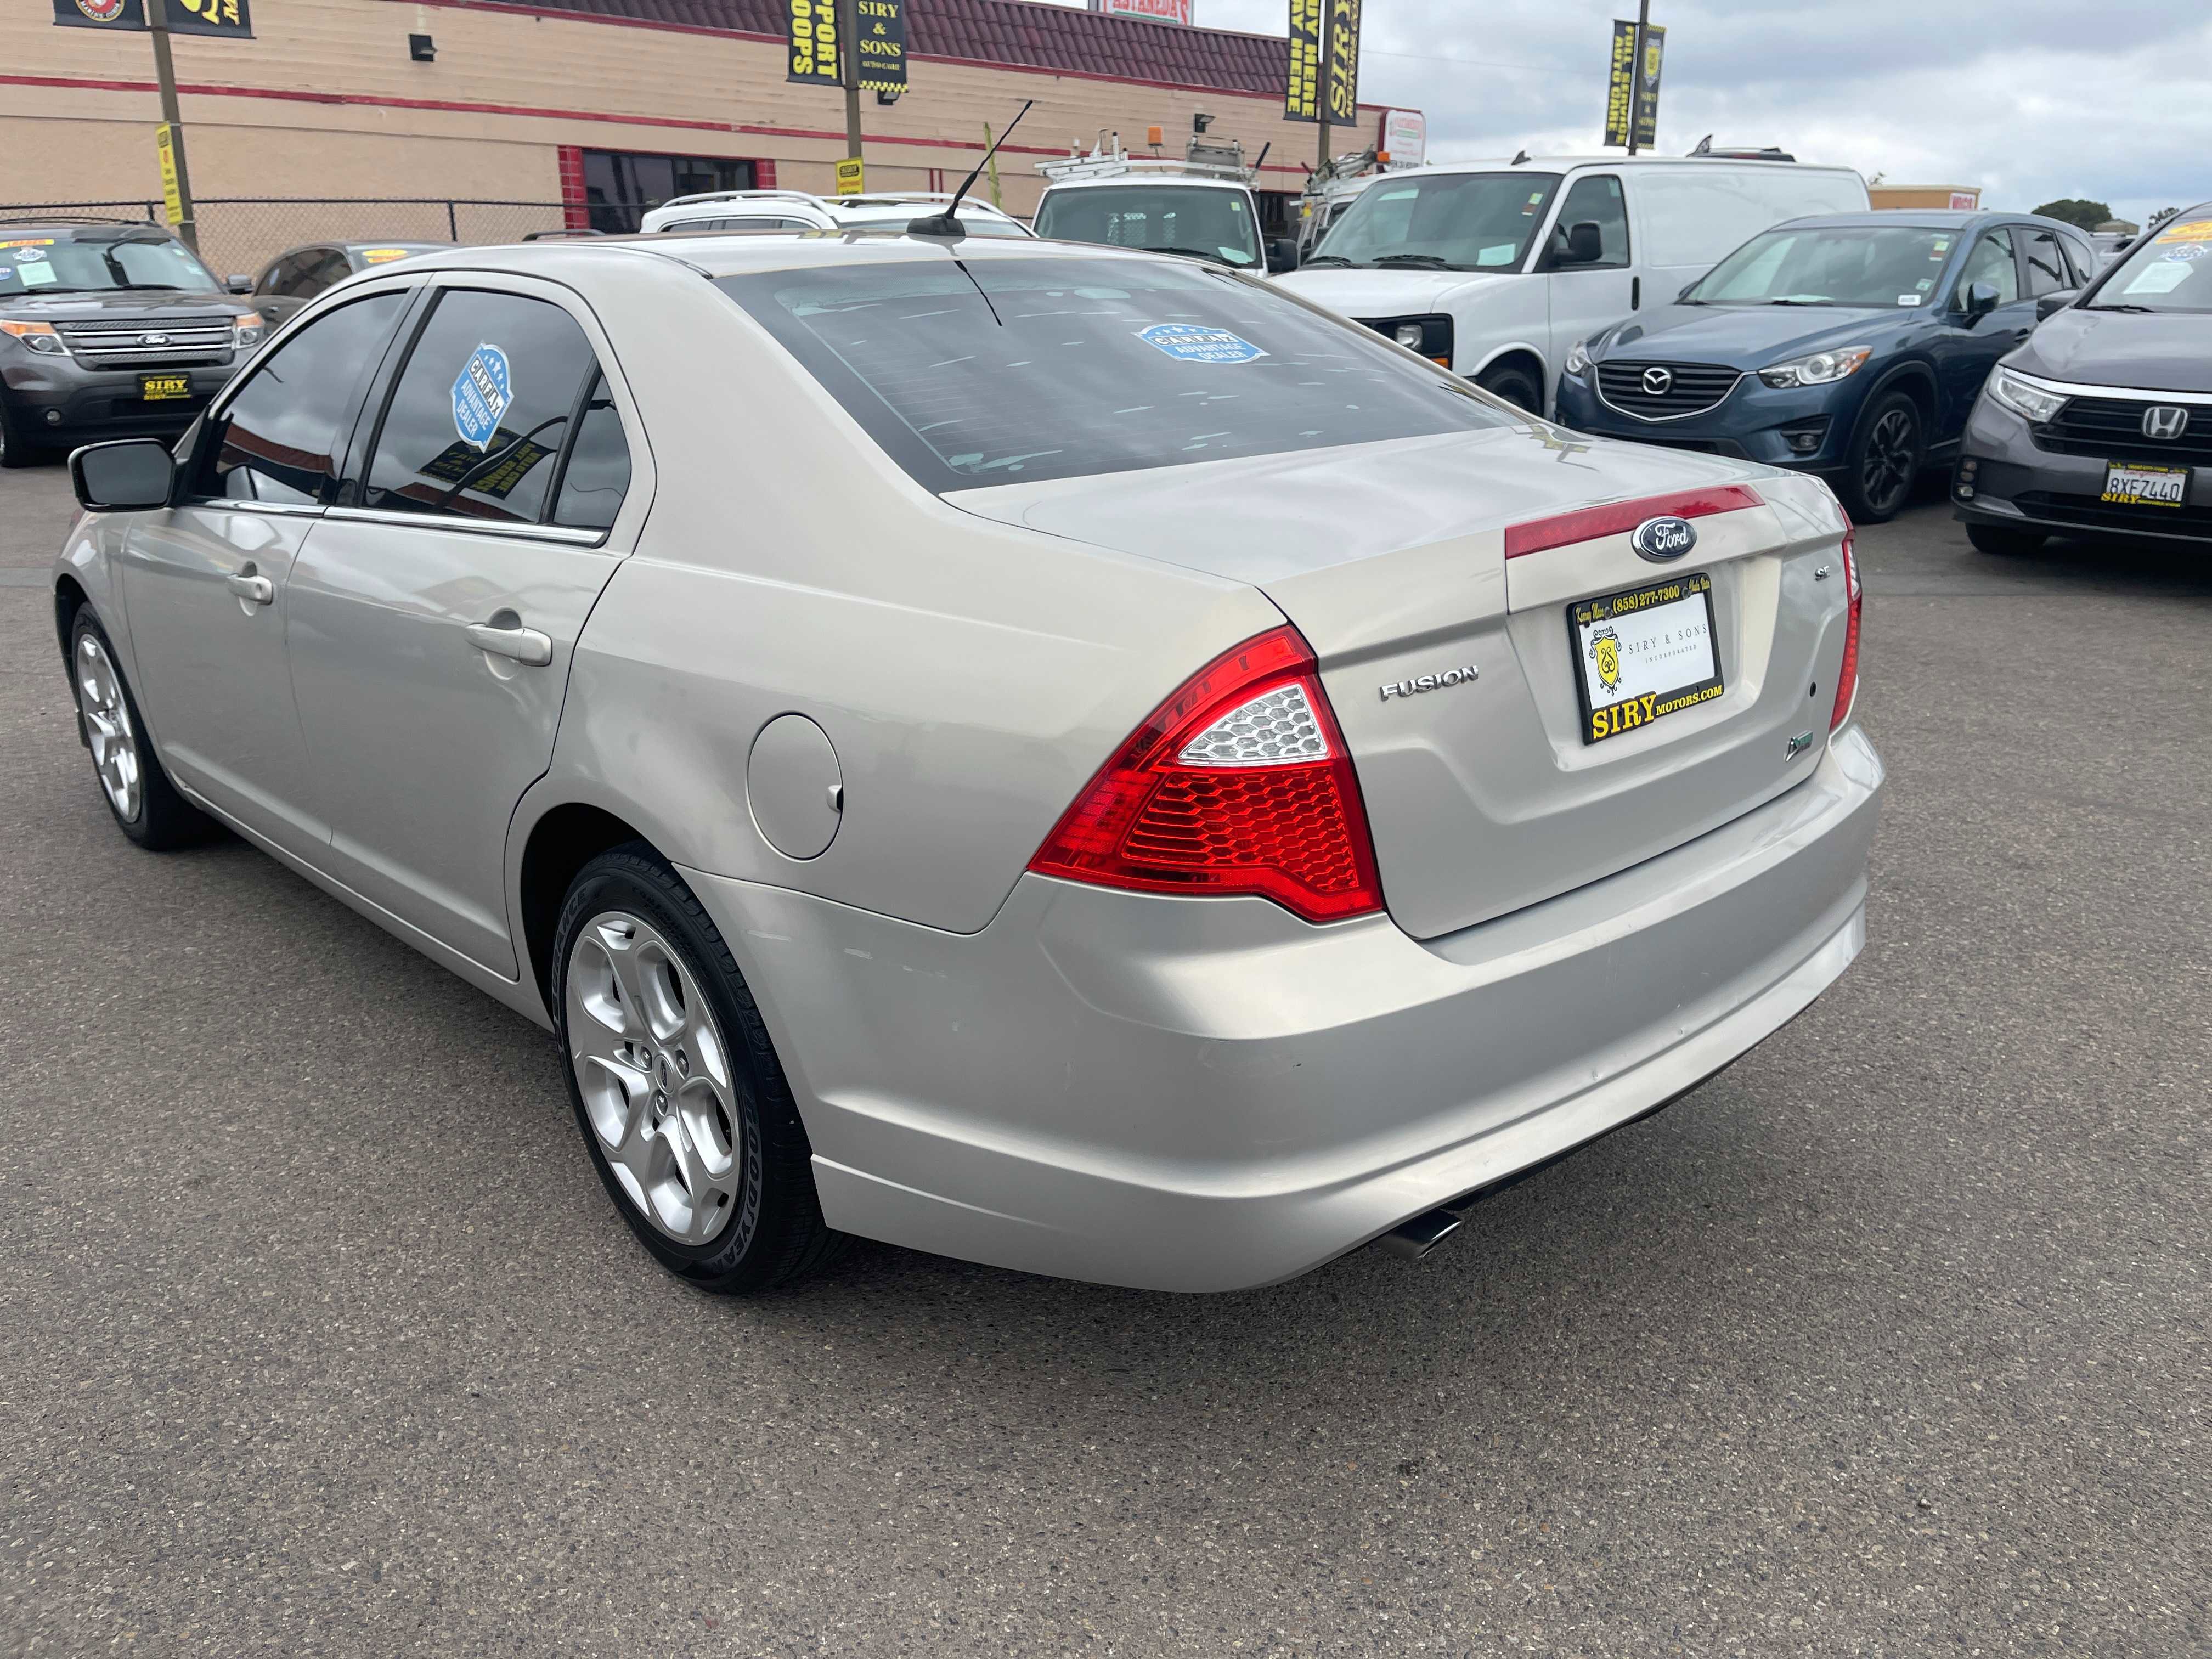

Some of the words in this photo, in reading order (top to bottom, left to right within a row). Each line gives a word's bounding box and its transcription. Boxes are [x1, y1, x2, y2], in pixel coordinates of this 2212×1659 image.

[858, 1, 898, 18] SIRY
[815, 0, 838, 80] PORT
[872, 22, 886, 36] &
[860, 39, 901, 57] SONS
[1287, 37, 1303, 112] HERE
[1301, 43, 1318, 117] HERE
[1155, 334, 1238, 346] CARFAX
[1175, 343, 1246, 354] ADVANTAGE
[1198, 351, 1248, 360] DEALER
[145, 380, 187, 391] SIRY
[470, 359, 506, 420] CARFAX
[456, 399, 478, 438] DEALER
[460, 380, 490, 431] ADVANTAGE
[1655, 522, 1689, 550] Ford
[1613, 594, 1638, 614] (858)
[1640, 585, 1680, 606] 277-7300
[1628, 636, 1656, 654] SIRY
[1664, 634, 1671, 644] &
[1678, 623, 1707, 640] SONS
[1645, 644, 1697, 663] INCORPORATED
[1380, 665, 1479, 702] FUSION
